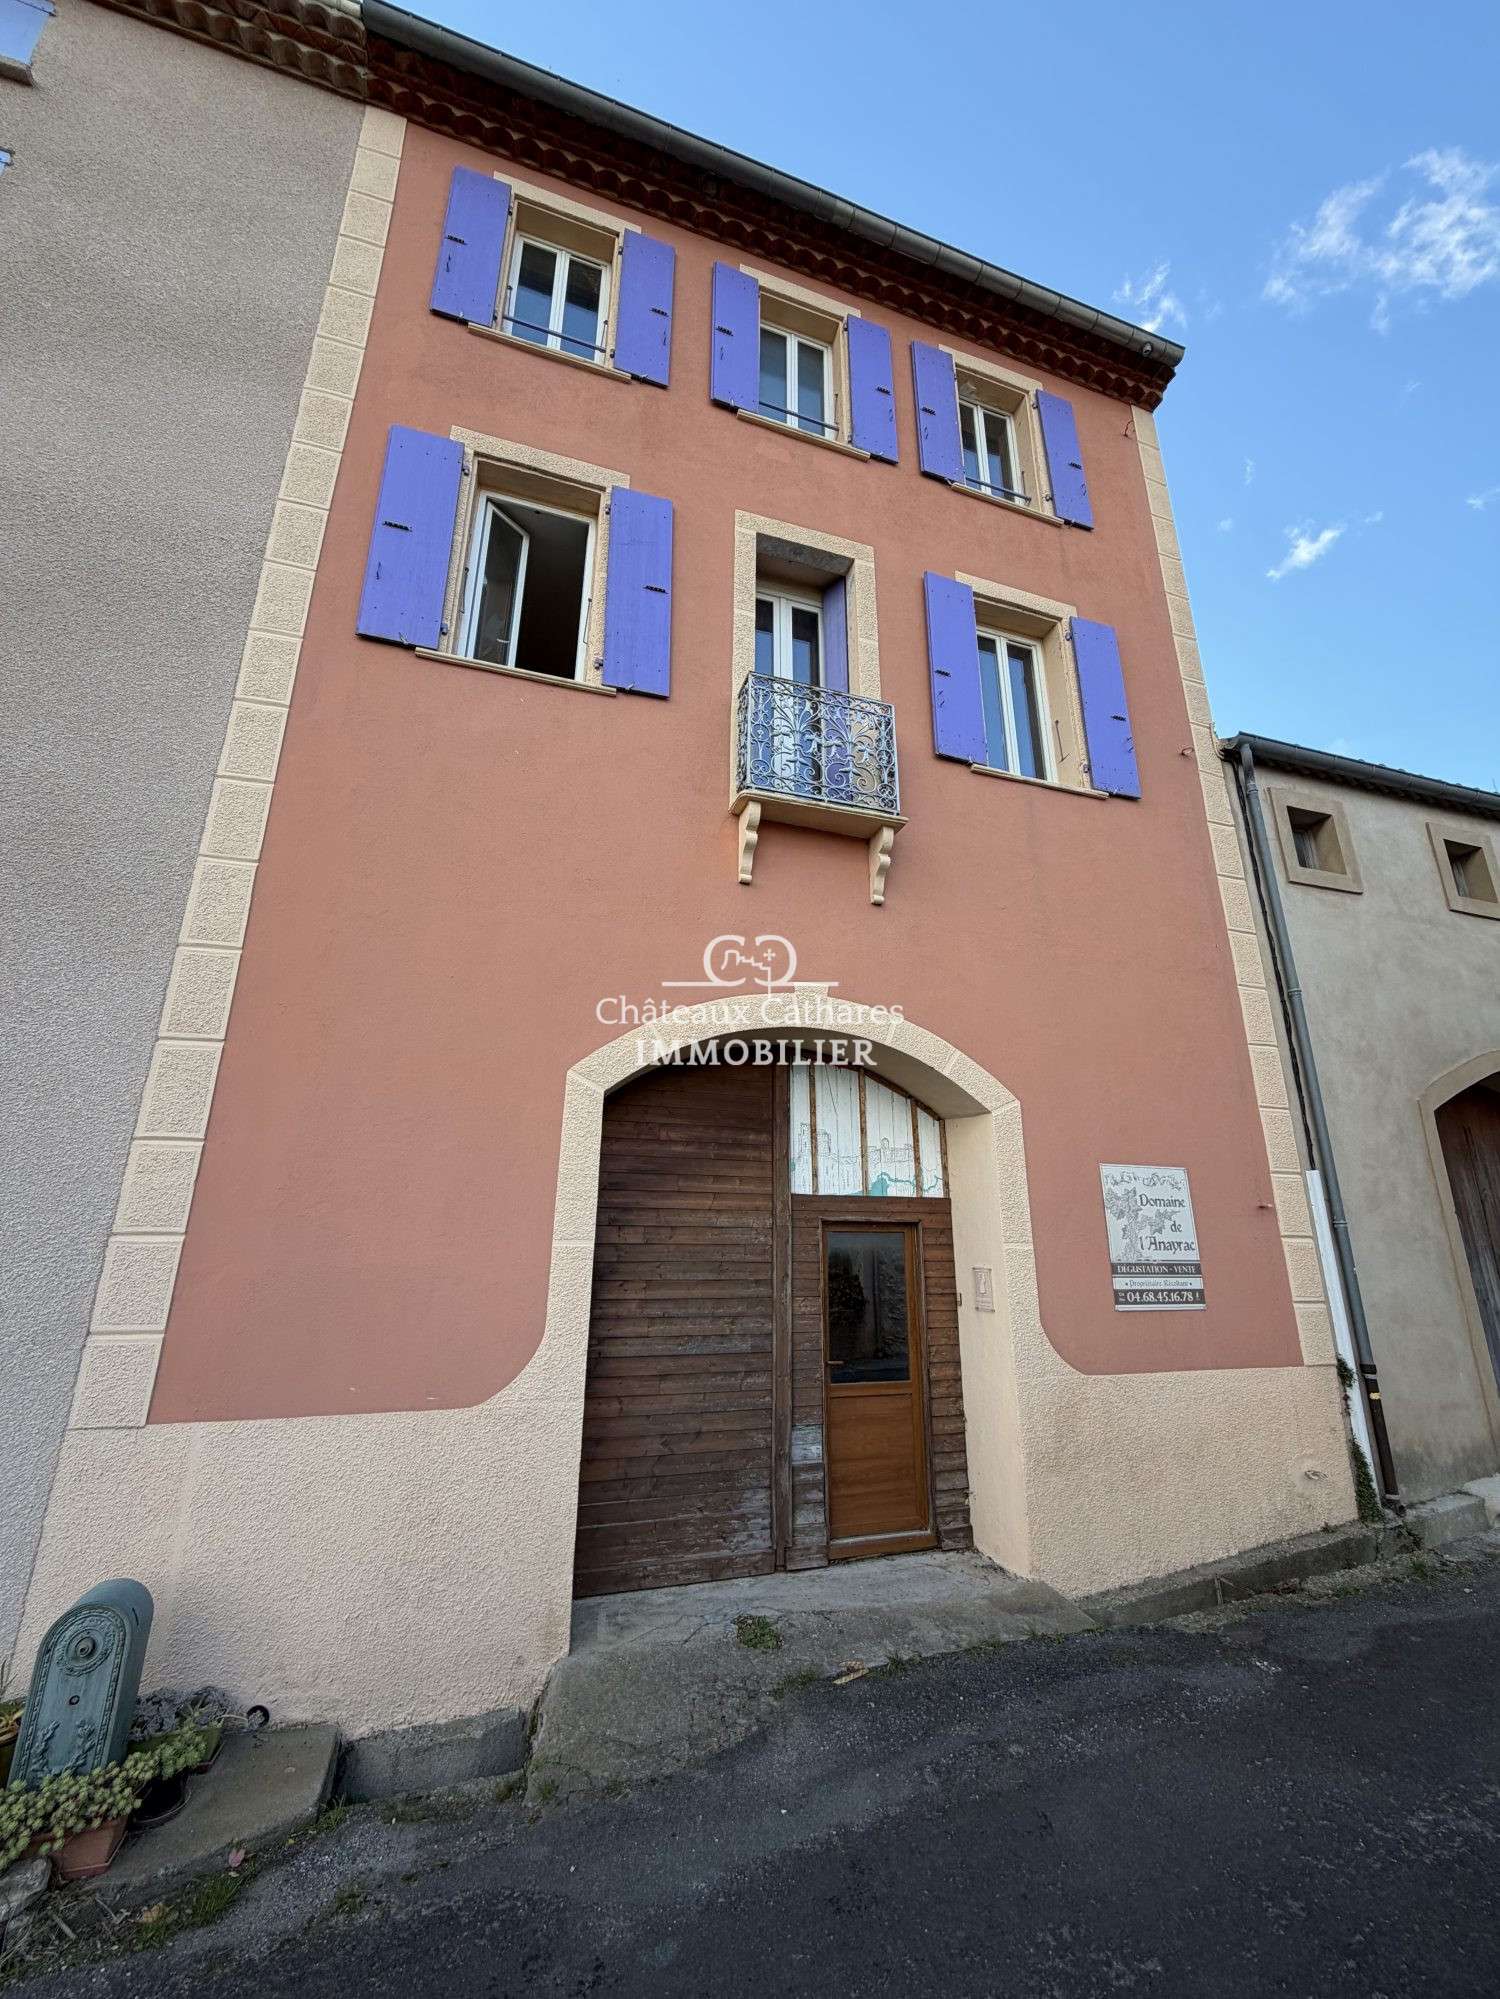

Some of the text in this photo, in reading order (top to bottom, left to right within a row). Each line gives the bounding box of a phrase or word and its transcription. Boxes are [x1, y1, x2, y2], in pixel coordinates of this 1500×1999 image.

[1138, 1193, 1186, 1208] Domaine
[1170, 1221, 1183, 1233] de
[1173, 1264, 1196, 1273] VENTE
[1126, 1291, 1194, 1303] 04.68.45.16.78
